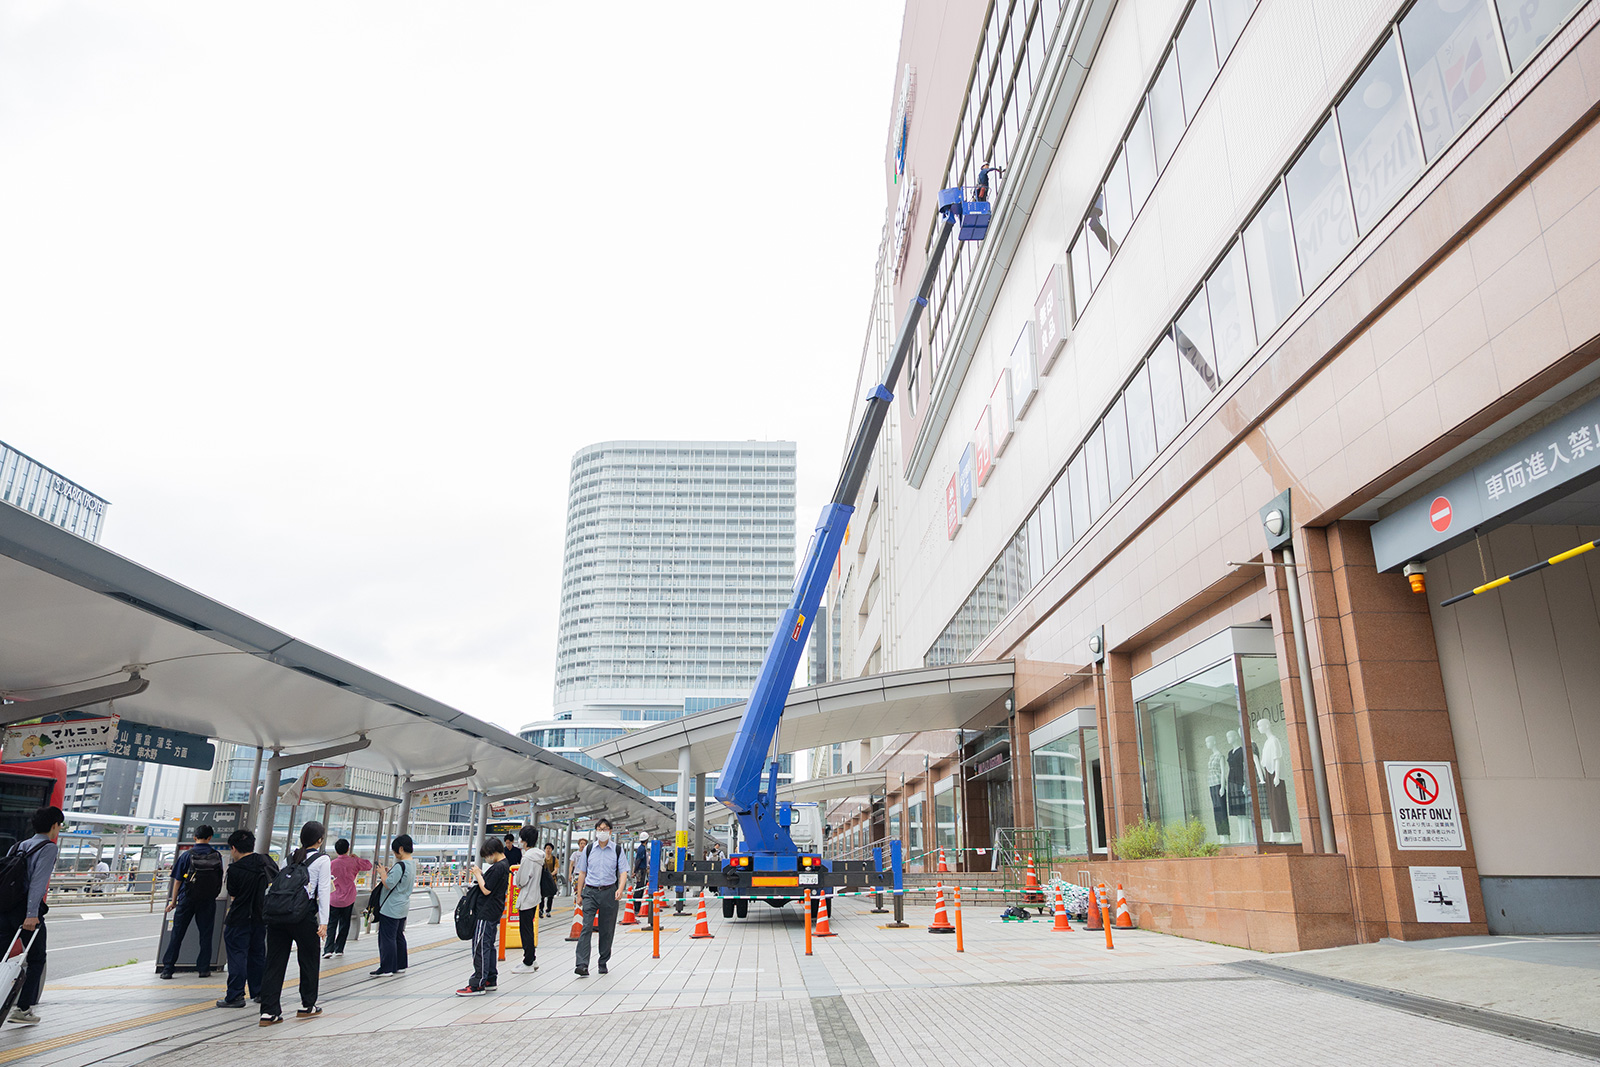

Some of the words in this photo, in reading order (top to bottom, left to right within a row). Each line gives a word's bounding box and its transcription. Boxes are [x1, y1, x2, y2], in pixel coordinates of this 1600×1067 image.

[1337, 94, 1440, 247] COTHING
[1040, 290, 1054, 329] 無印
[1041, 318, 1056, 355] 良品
[1014, 351, 1030, 393] GU
[1248, 703, 1285, 729] PAQUE
[52, 726, 109, 738] マルニョン
[137, 746, 158, 760] 串木野
[173, 746, 188, 758] 方面
[1399, 808, 1427, 820] STAFF
[1429, 808, 1452, 820] ONLY
